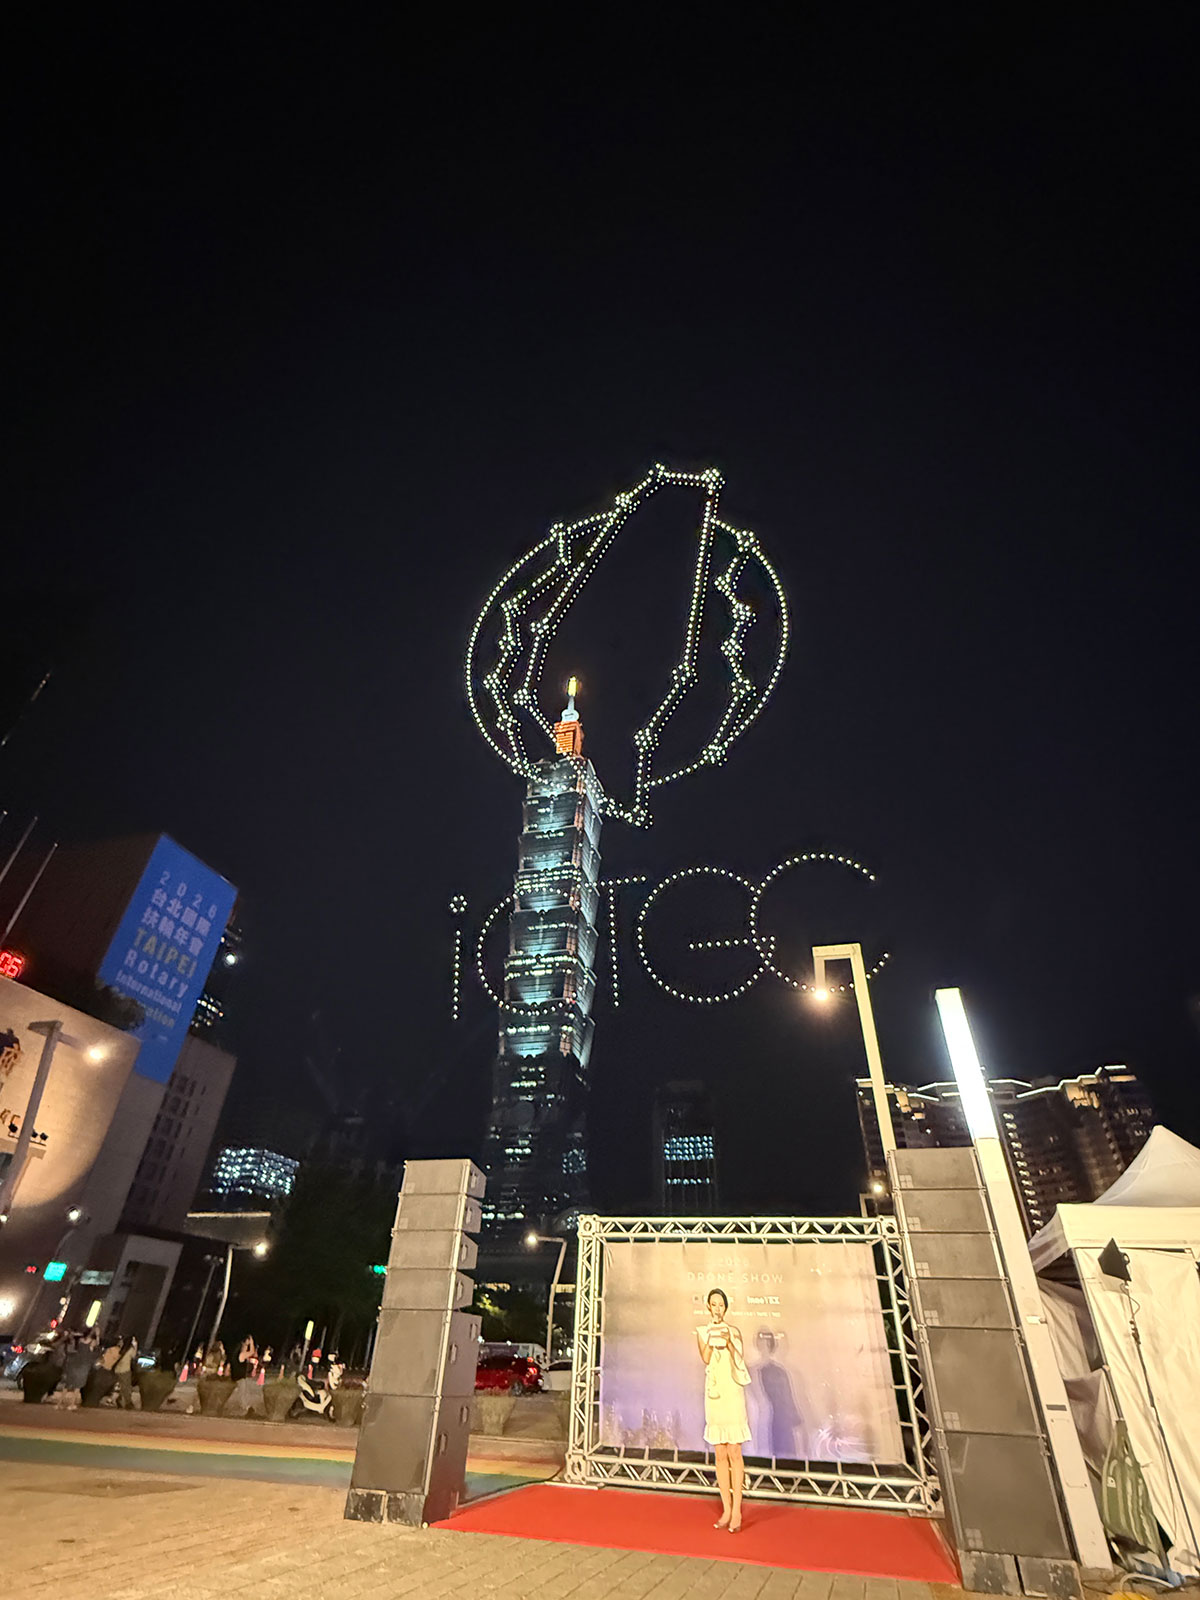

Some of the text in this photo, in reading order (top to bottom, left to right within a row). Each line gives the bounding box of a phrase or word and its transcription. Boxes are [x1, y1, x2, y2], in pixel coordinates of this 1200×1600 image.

[159, 870, 218, 920] 2026
[123, 948, 189, 999] Rotary
[133, 926, 198, 978] TAIPEI
[115, 968, 183, 1015] International
[687, 1270, 784, 1285] DRONE SHOW
